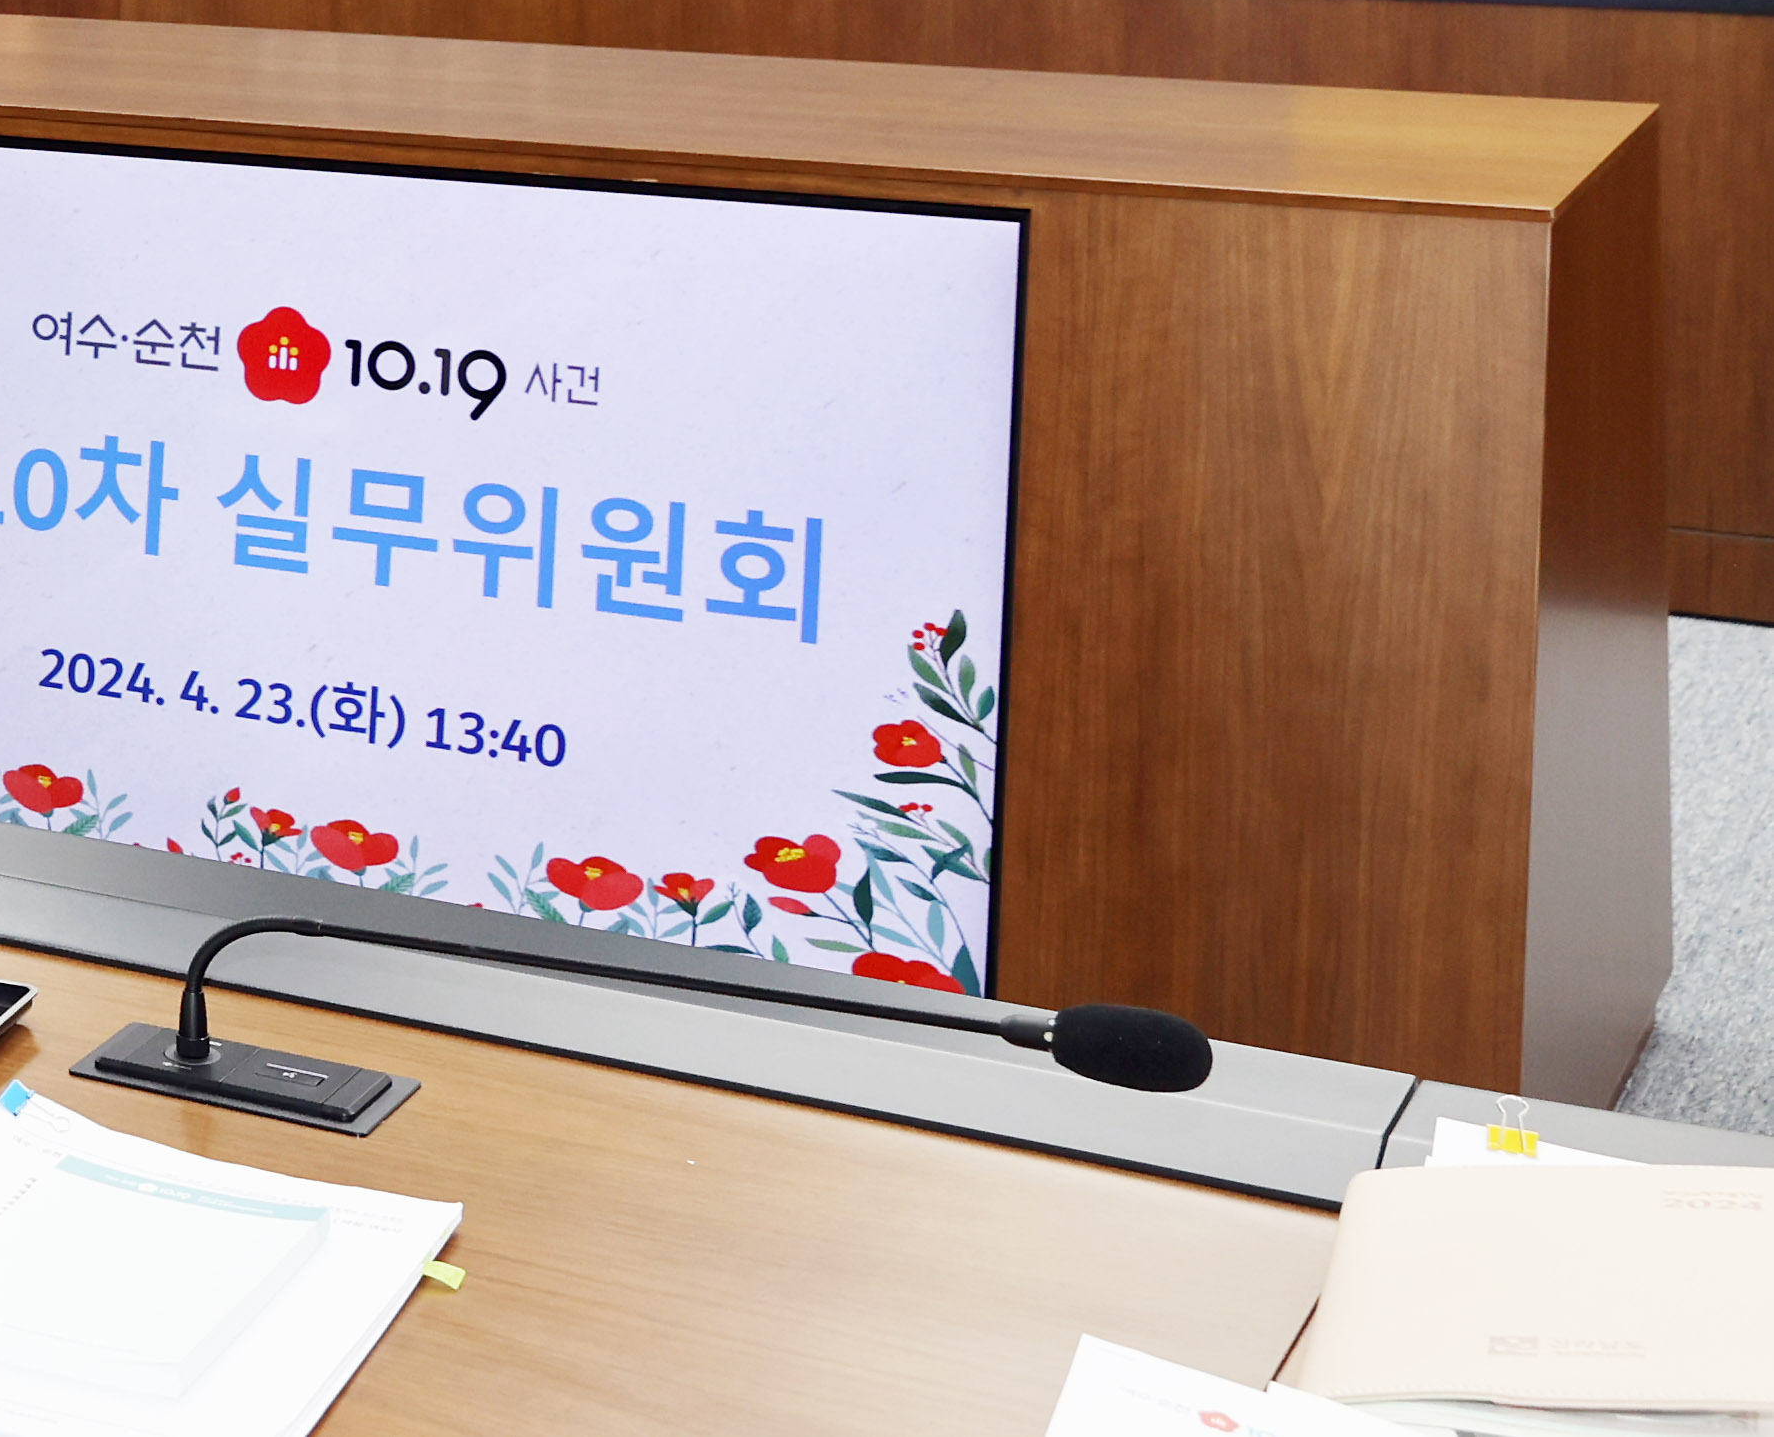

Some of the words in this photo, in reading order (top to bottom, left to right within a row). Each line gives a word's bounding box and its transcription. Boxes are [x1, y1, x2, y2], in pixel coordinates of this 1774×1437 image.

[31, 310, 222, 373] 여수·순천
[344, 338, 508, 421] 10.19
[524, 361, 601, 406] 사건
[216, 454, 824, 645] 실무위원회
[38, 648, 165, 706] 2024.
[179, 670, 220, 715] 4.
[235, 678, 406, 749] 23.(화)
[425, 707, 567, 768] 13:40
